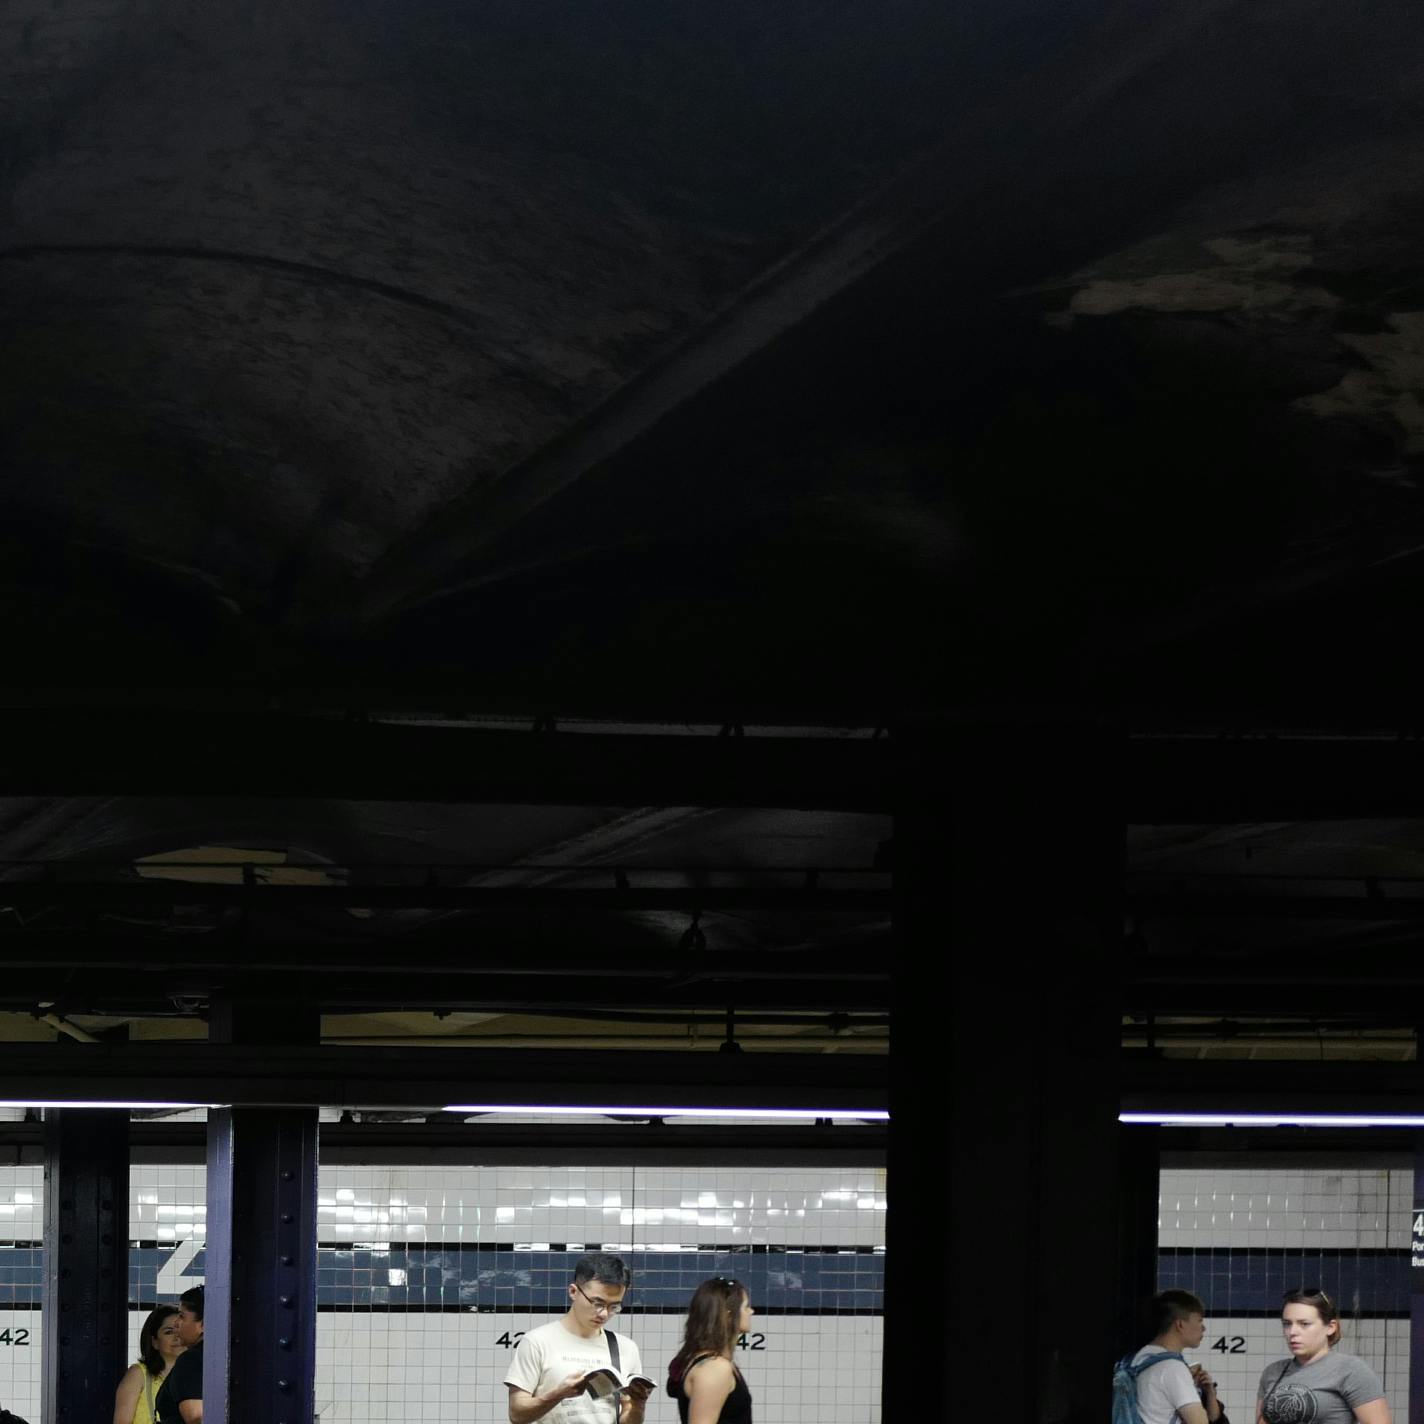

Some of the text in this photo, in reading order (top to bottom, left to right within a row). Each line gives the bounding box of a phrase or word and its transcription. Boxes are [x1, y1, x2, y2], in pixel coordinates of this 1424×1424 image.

[1413, 1213, 1424, 1236] 4
[495, 1331, 526, 1349] 42
[735, 1331, 766, 1350] 42
[1211, 1336, 1246, 1354] 42
